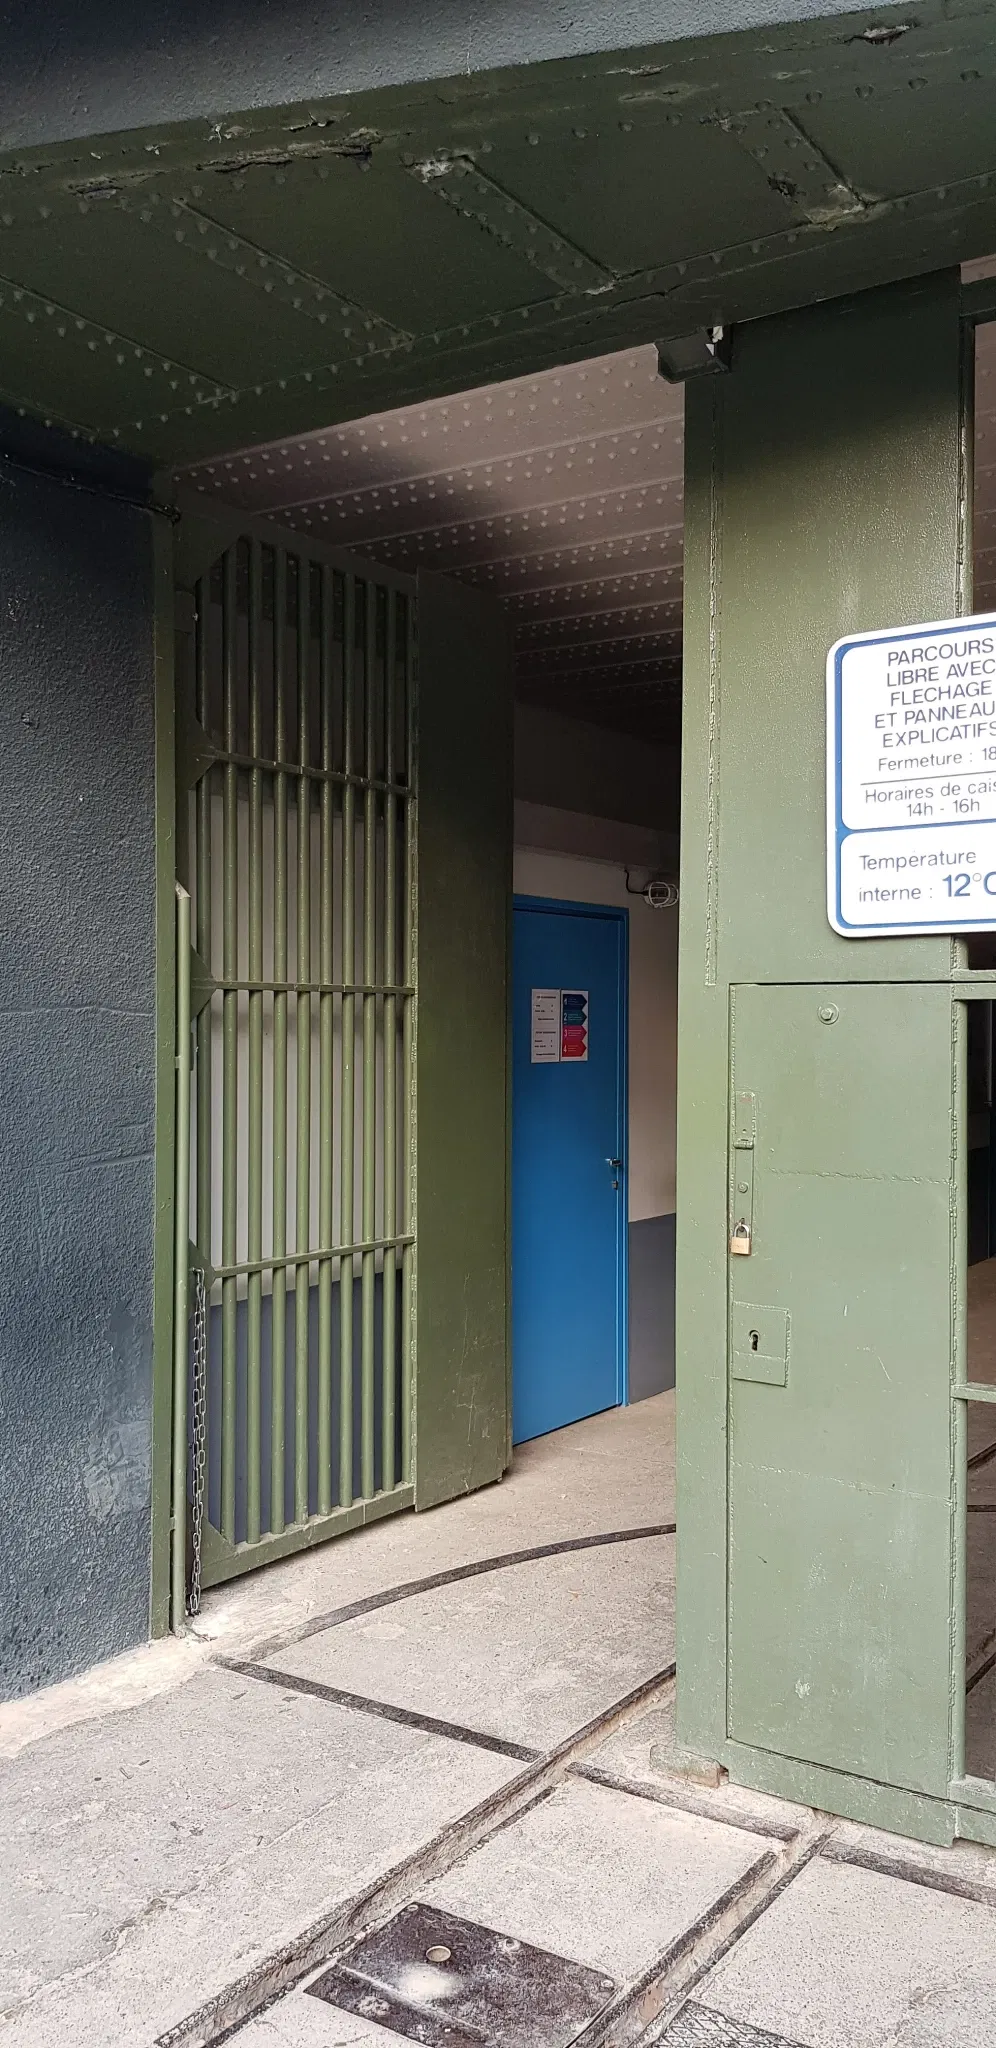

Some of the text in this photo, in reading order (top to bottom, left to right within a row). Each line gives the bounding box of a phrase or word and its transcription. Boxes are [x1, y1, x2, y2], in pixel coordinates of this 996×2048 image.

[888, 637, 994, 667] PARCOURS
[887, 658, 996, 687] LIBRE AVEC
[890, 679, 993, 707] FLECHAGE
[875, 700, 996, 729] ET PANNEAU
[878, 753, 962, 772] Fermeture
[969, 752, 973, 762] :
[865, 786, 934, 804] Horaires
[940, 782, 961, 797] de
[906, 802, 933, 817] 14h
[953, 798, 980, 813] 16h
[858, 887, 922, 902] interne
[929, 887, 933, 898] :
